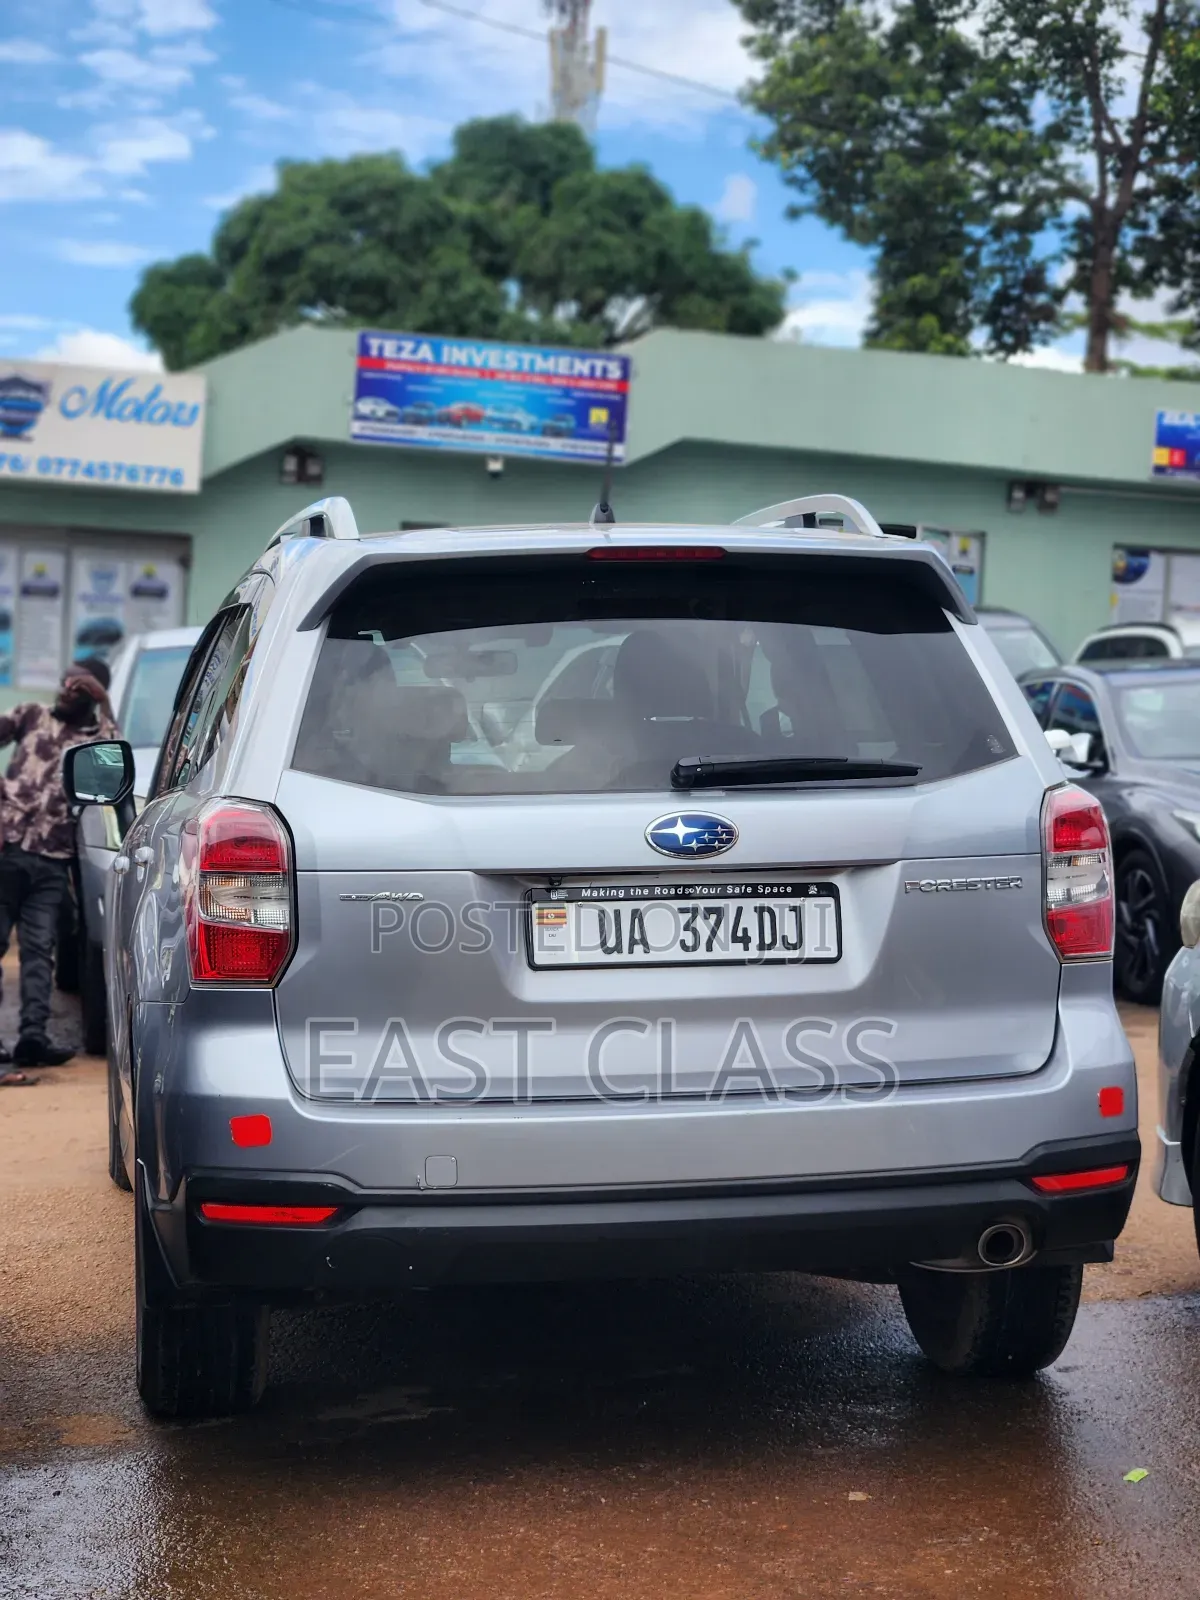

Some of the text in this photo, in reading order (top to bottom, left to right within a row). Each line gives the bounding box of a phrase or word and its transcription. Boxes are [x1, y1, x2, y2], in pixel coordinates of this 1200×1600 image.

[366, 337, 435, 363] TEZA
[442, 343, 622, 380] INVESTMENTS
[581, 888, 624, 898] Making
[630, 887, 648, 896] the
[695, 885, 722, 894] Your
[726, 884, 752, 894] Safe
[757, 884, 793, 894] Space
[904, 876, 1022, 893] FORESTER
[370, 891, 424, 901] AWD
[598, 904, 804, 955] UA 374DJ
